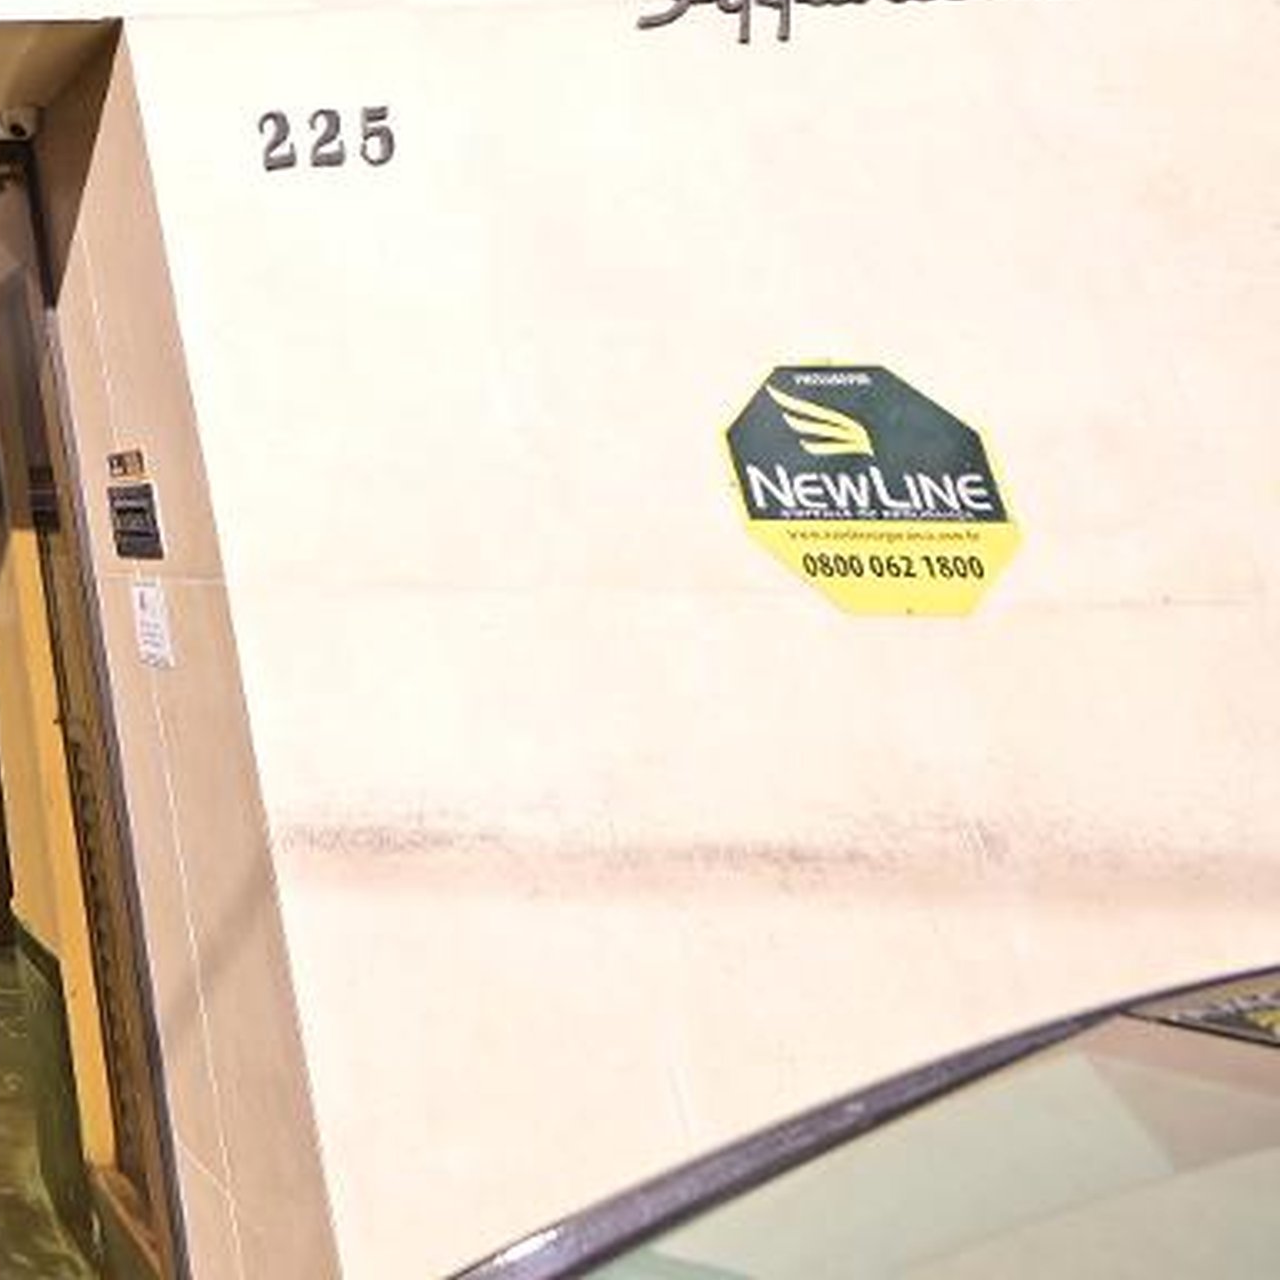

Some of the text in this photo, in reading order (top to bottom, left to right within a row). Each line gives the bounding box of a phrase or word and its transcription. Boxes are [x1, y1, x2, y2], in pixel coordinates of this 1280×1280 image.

[258, 106, 396, 172] 225
[802, 553, 985, 580] 0800 062 1800
